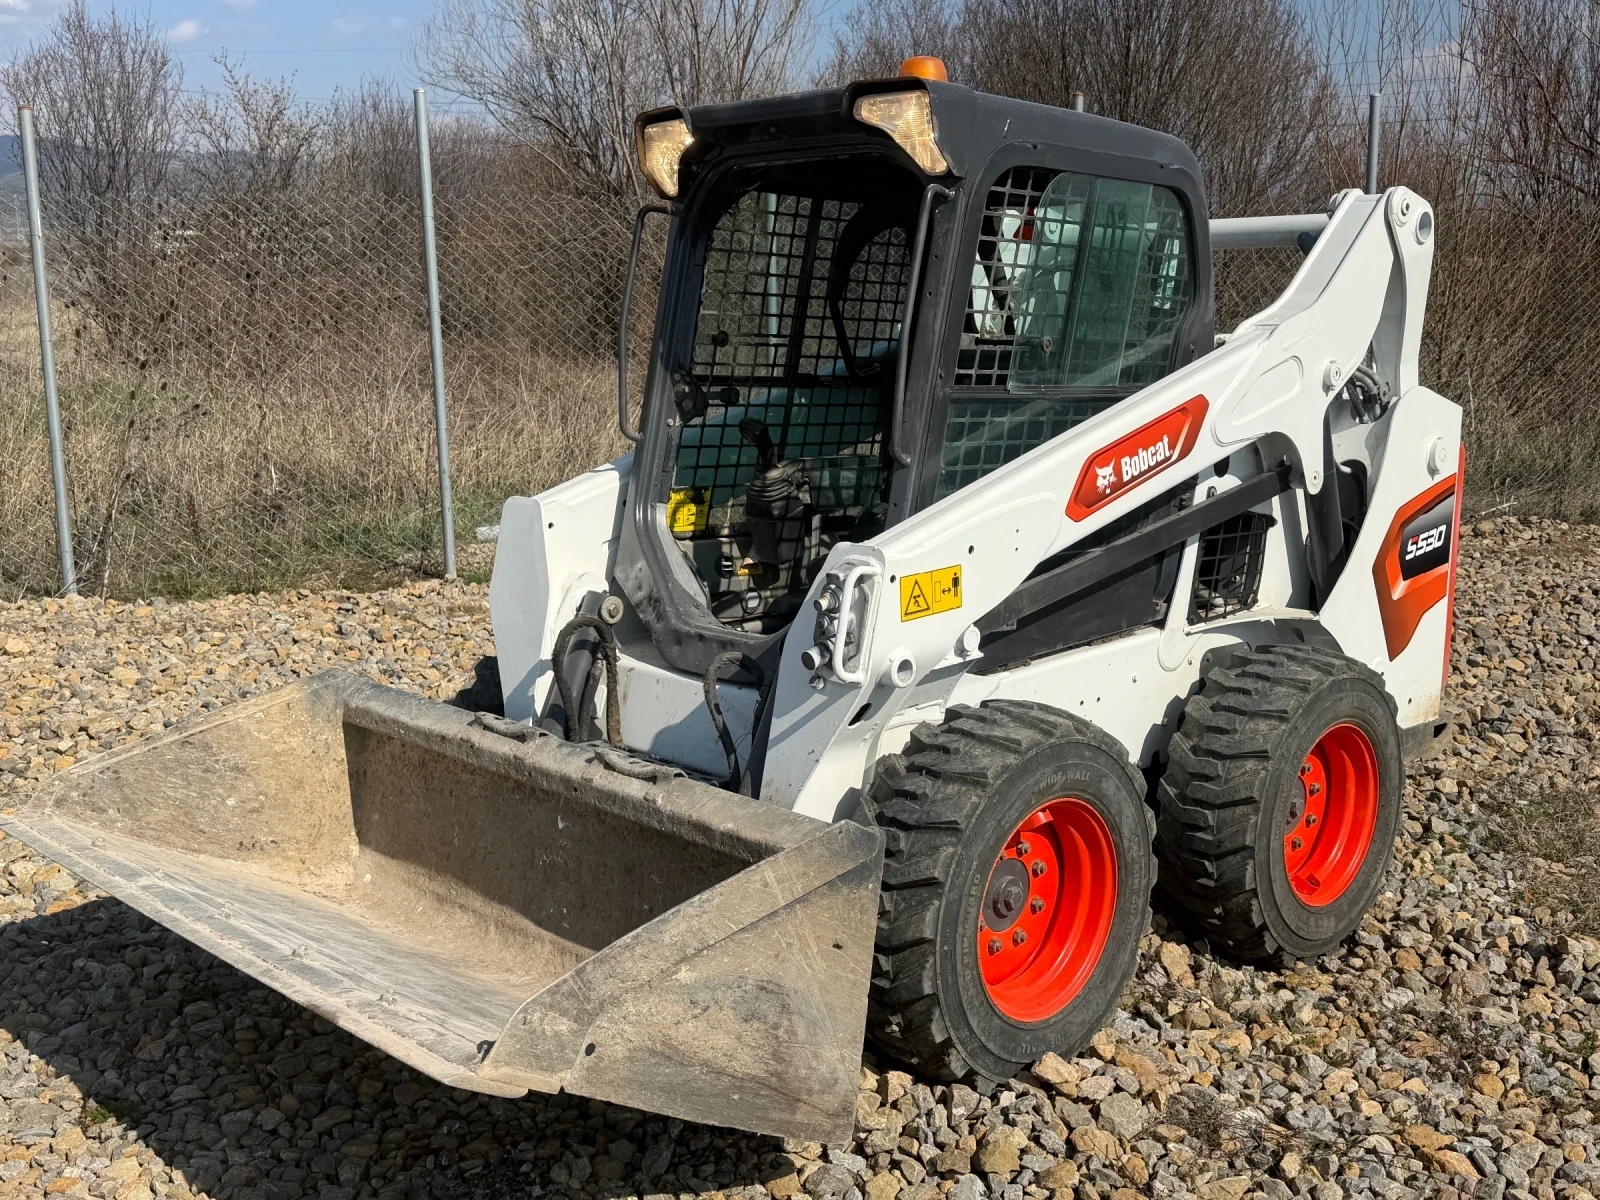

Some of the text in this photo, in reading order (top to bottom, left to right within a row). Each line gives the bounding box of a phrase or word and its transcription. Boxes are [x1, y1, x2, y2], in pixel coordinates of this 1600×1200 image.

[1120, 434, 1170, 482] Bobcat
[1405, 524, 1447, 561] S530
[1038, 769, 1091, 790] WIDE WALL
